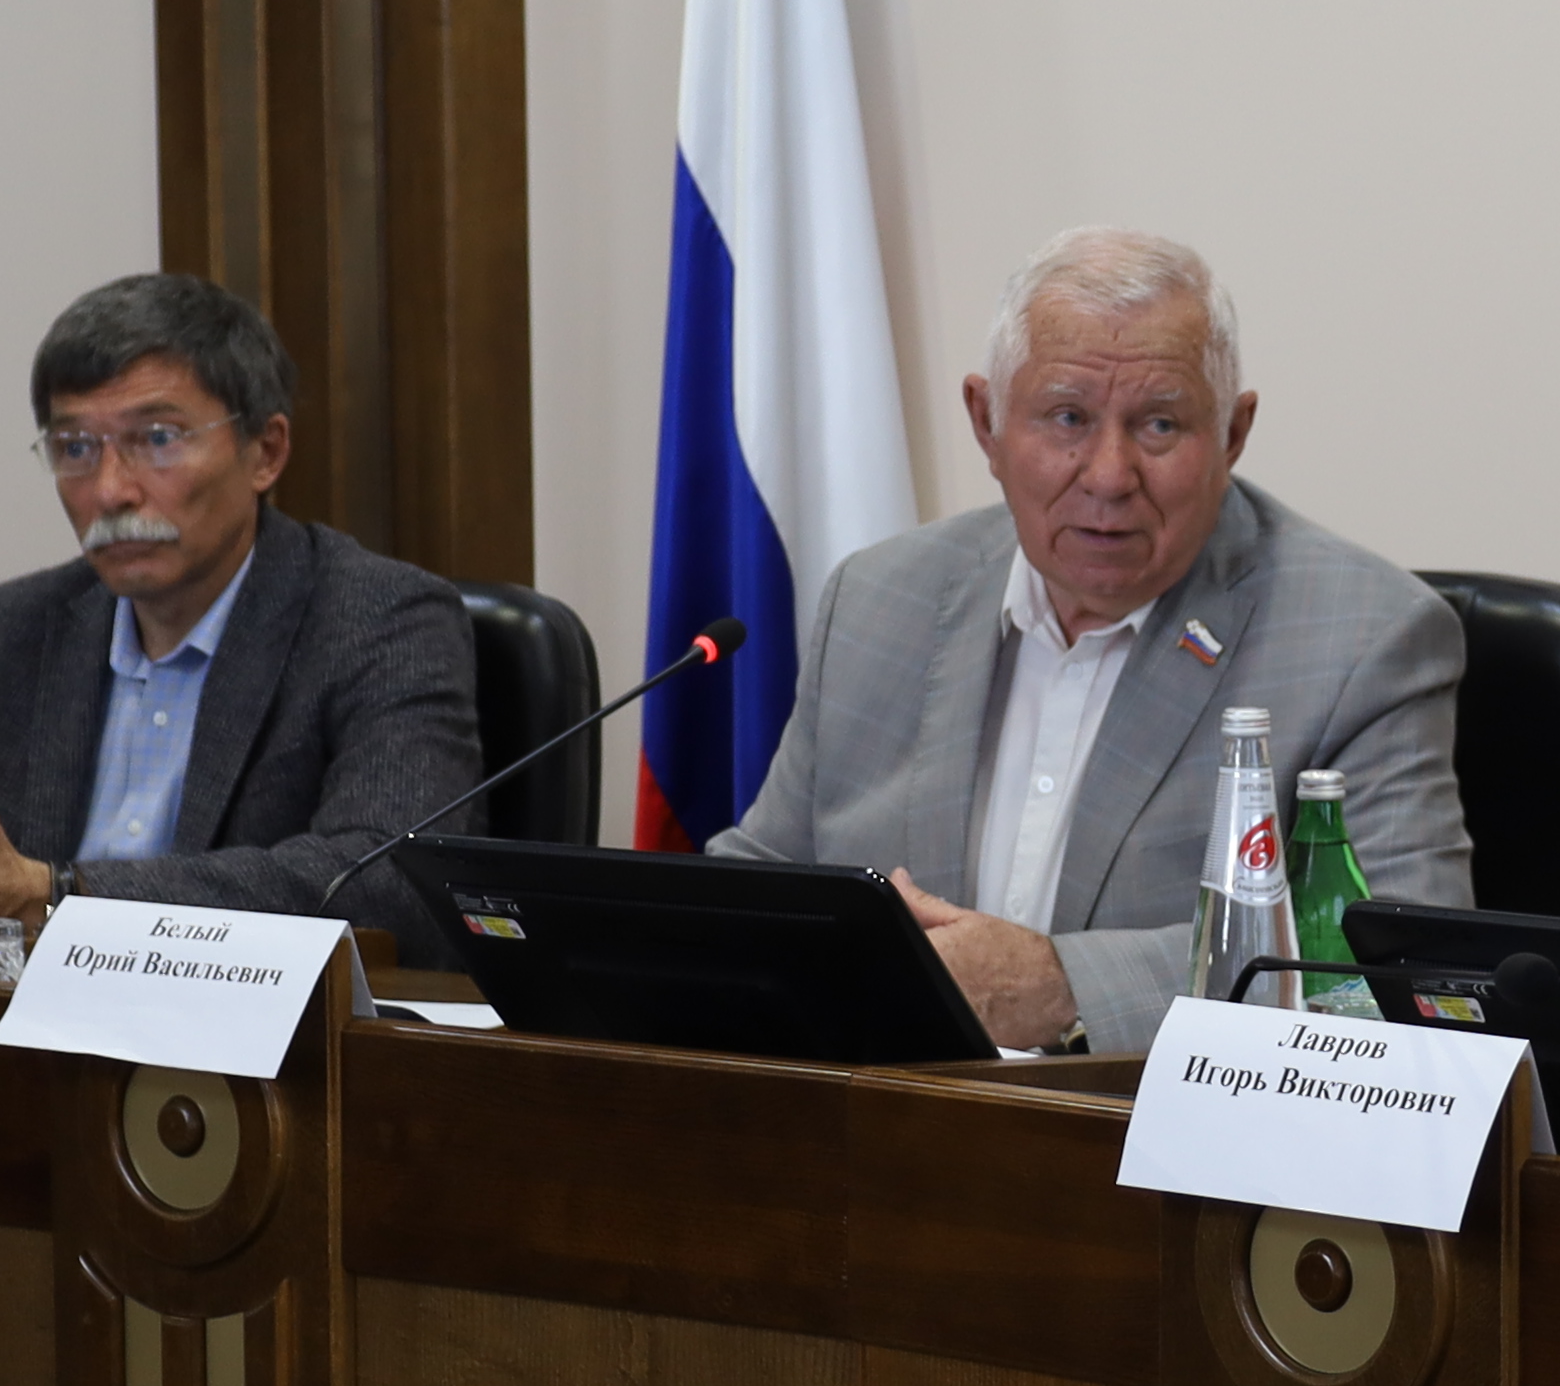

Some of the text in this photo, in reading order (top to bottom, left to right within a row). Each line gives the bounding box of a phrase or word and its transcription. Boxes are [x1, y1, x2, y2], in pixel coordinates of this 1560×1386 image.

[149, 917, 232, 943] Белый
[63, 944, 284, 986] Юрий Васильевич
[1277, 1024, 1389, 1062] Лавров
[1181, 1055, 1457, 1117] Игорь Викторович
